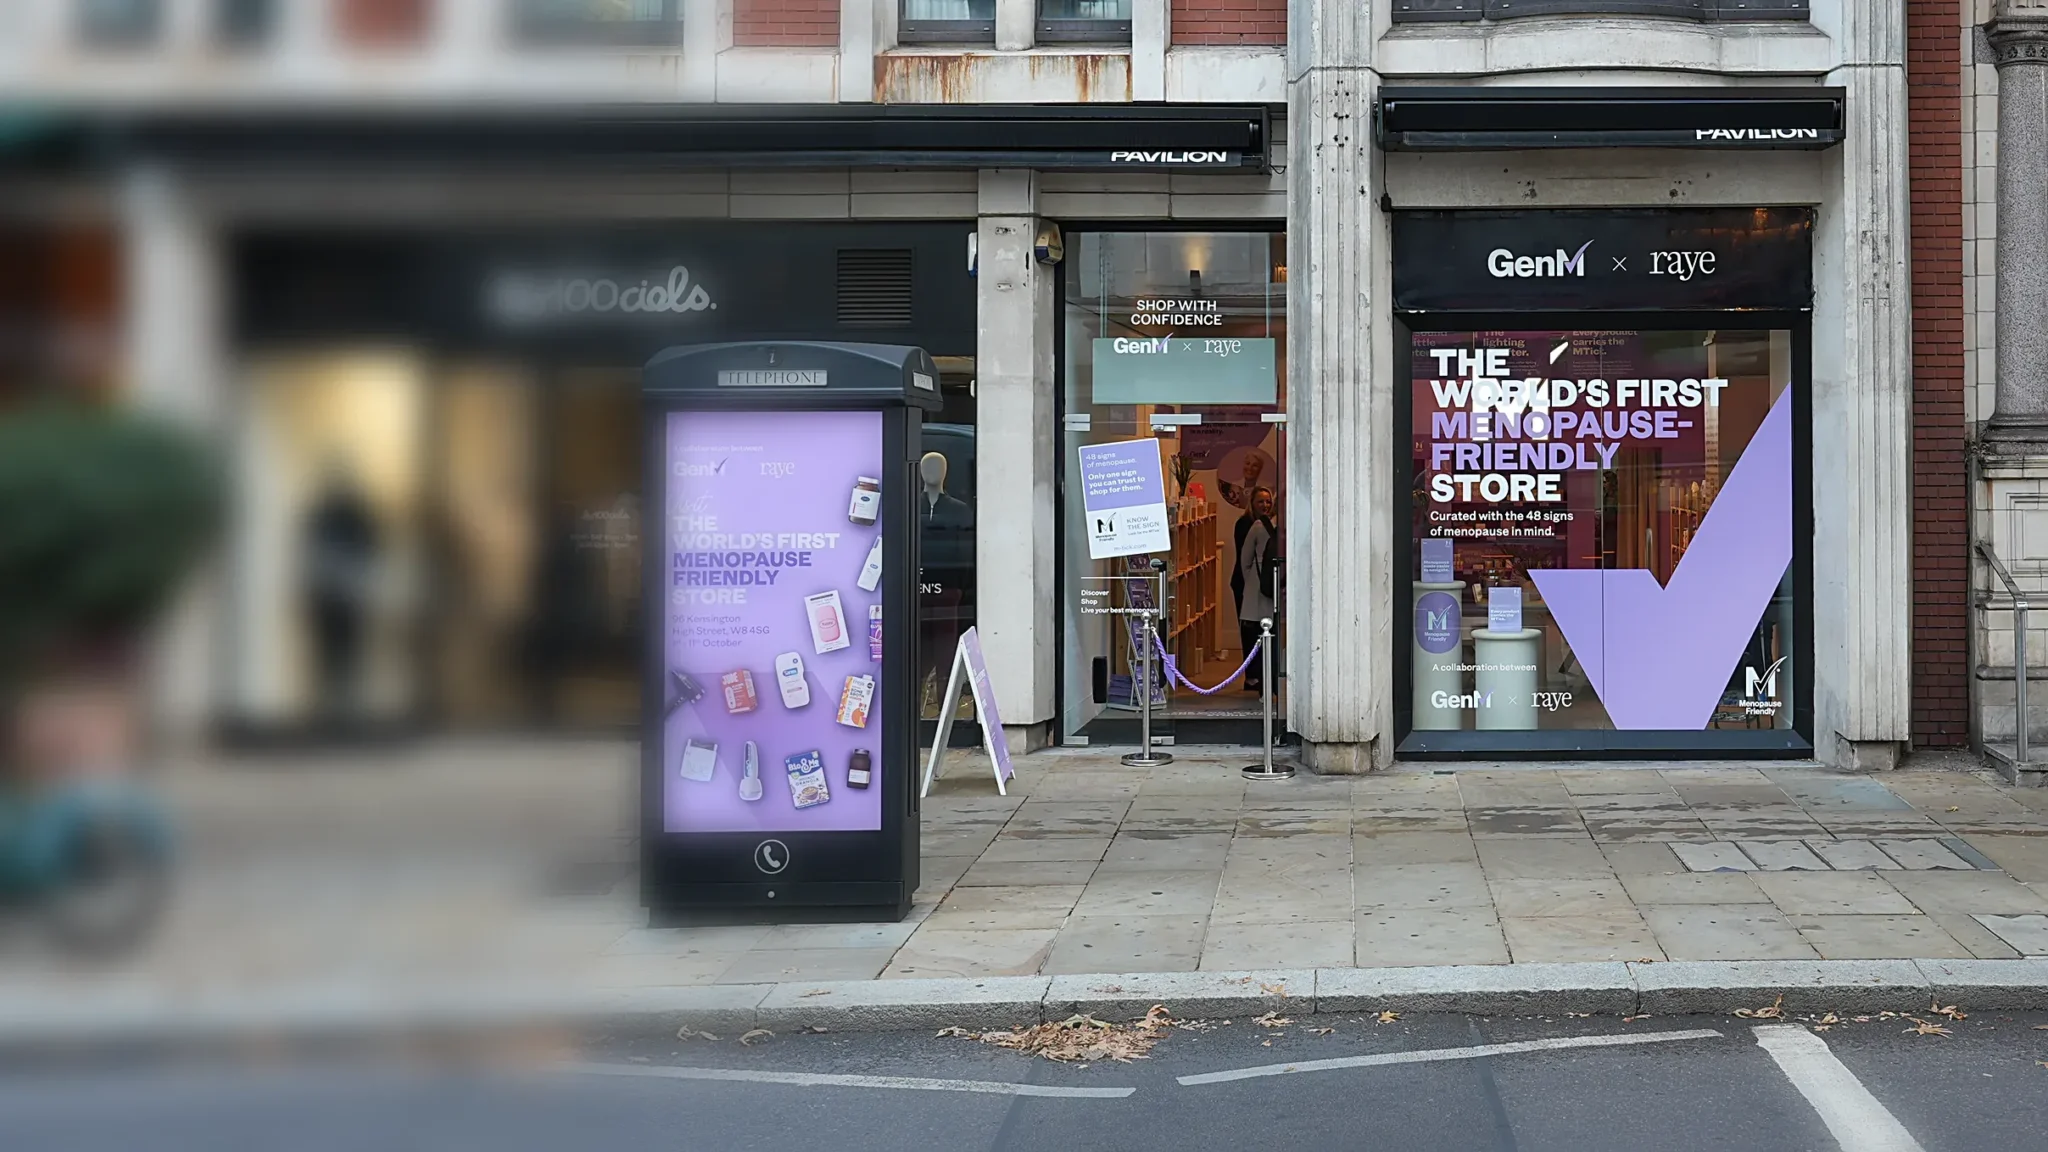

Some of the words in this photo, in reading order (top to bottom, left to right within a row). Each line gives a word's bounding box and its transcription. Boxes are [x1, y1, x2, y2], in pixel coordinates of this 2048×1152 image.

[1696, 129, 1817, 140] PAVILION
[1111, 151, 1226, 163] PAVILION
[1487, 239, 1594, 278] GenM
[1649, 250, 1715, 281] raye
[1136, 300, 1176, 311] SHOP
[1178, 300, 1217, 311] WITH
[1130, 313, 1222, 326] CONFIDENCE
[1113, 332, 1174, 354] GenM
[1203, 339, 1242, 357] raye
[1483, 337, 1525, 348] lighting
[1572, 338, 1606, 346] carries
[1608, 338, 1625, 346] the
[1429, 348, 1510, 377] THE
[728, 371, 820, 384] TELEPHONE
[1618, 378, 1728, 408] FIRST
[1431, 411, 1693, 440] MENOPAUSE-
[1097, 452, 1116, 460] signs
[1431, 442, 1621, 471] FRIENDLY
[673, 456, 729, 477] GenM
[760, 461, 794, 479] raye
[1095, 458, 1137, 468] menopause.
[1088, 472, 1105, 480] Only
[1121, 469, 1137, 477] sign
[1089, 481, 1104, 489] you
[1118, 477, 1137, 485] trust
[1430, 473, 1562, 503] STORE
[1090, 488, 1108, 497] shop
[1109, 486, 1121, 494] for
[1122, 484, 1143, 492] them.
[1126, 516, 1149, 524] KNOW
[1430, 511, 1476, 521] Curated
[1479, 510, 1501, 521] with
[1505, 510, 1524, 521] the
[1526, 511, 1541, 521] 48
[1543, 510, 1574, 523] signs
[672, 516, 718, 532] THE
[1142, 521, 1160, 529] SIGN
[1430, 526, 1442, 536] of
[1444, 527, 1509, 538] menopause
[1512, 526, 1522, 536] in
[1524, 526, 1555, 536] mind.
[672, 533, 774, 550] WORLD'S
[777, 533, 840, 549] FIRST
[673, 551, 812, 567] MENOPAUSE
[673, 570, 780, 586] FRIENDLY
[672, 588, 747, 604] STORE
[1081, 598, 1098, 606] Shop
[687, 614, 741, 625] Kensington
[696, 626, 729, 636] Street,
[730, 626, 748, 635] W8
[749, 626, 770, 635] 4SG
[702, 638, 743, 647] October
[1440, 663, 1498, 671] collaboration
[1499, 663, 1537, 671] between
[1430, 686, 1496, 709] GenM
[1530, 691, 1572, 711] raye
[1738, 700, 1782, 708] Menopause
[1745, 707, 1775, 717] Friendly
